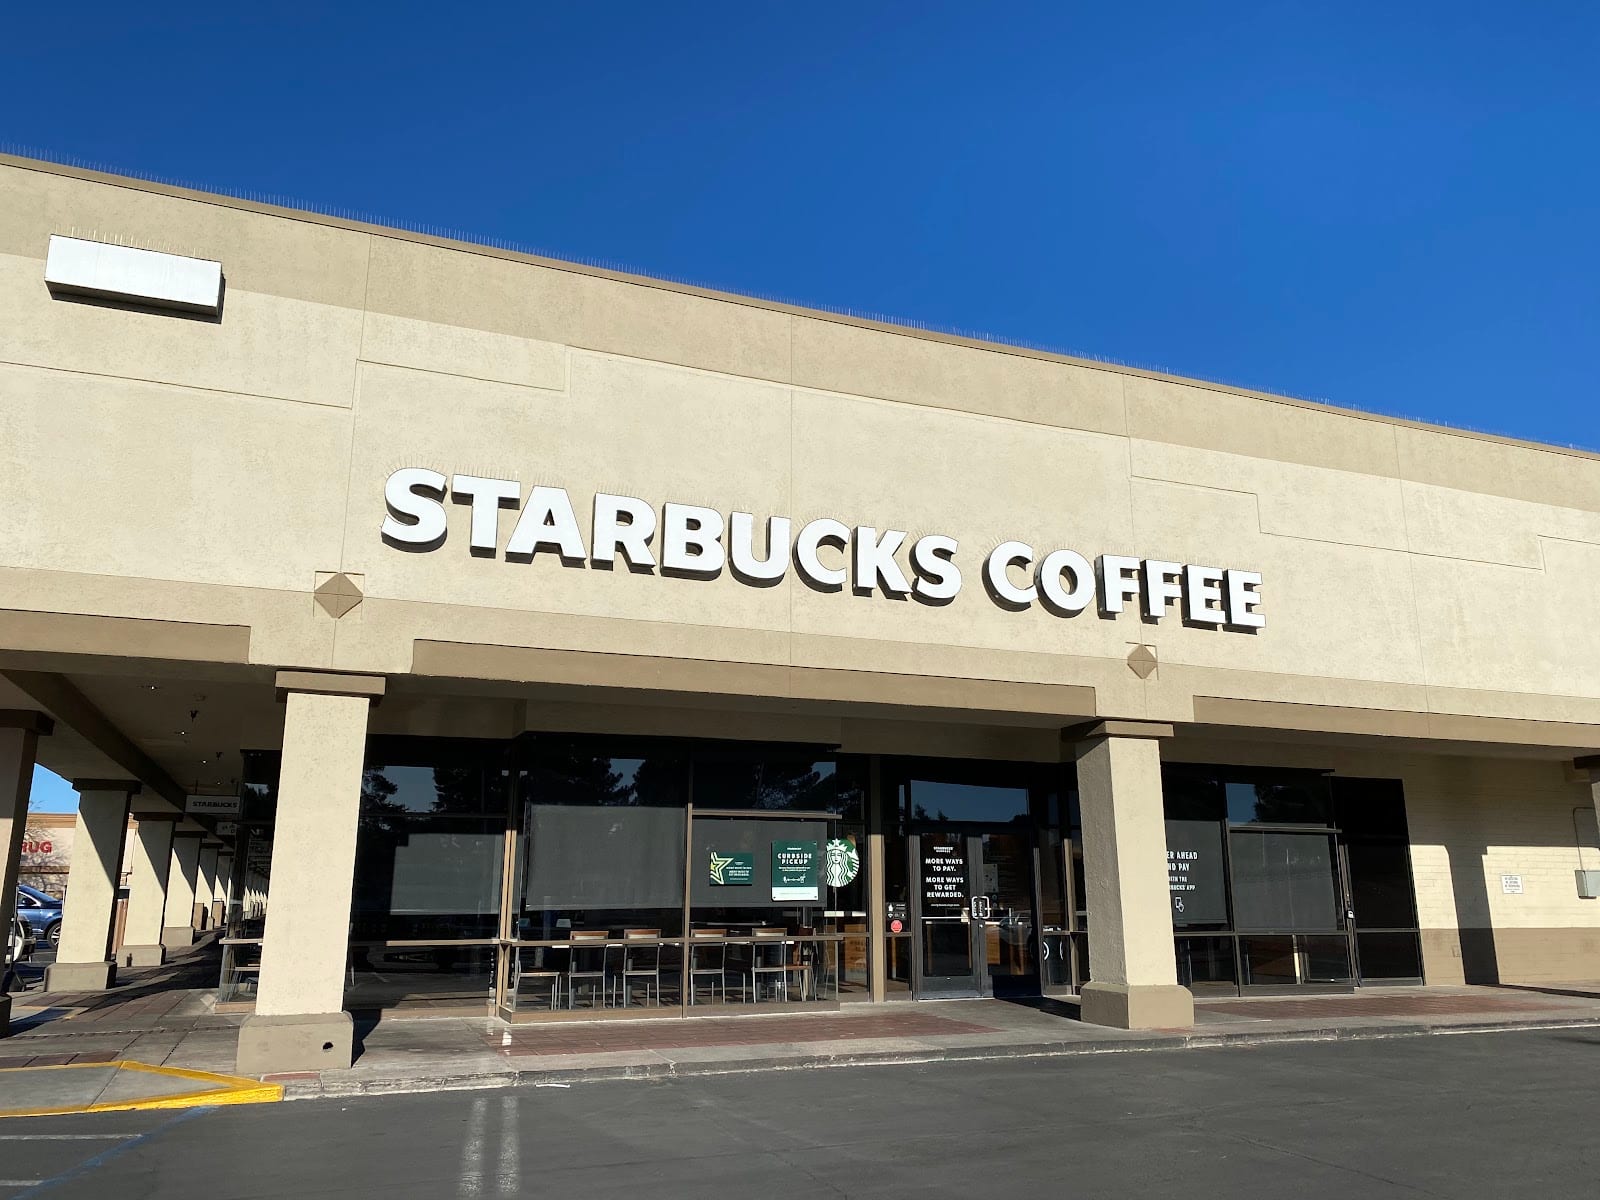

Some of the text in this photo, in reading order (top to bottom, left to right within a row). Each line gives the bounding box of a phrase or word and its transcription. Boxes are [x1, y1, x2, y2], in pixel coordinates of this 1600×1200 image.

[381, 467, 1266, 635] STARBUCKS COFFEE
[1176, 851, 1198, 860] AHEAD
[1178, 862, 1190, 871] PAY
